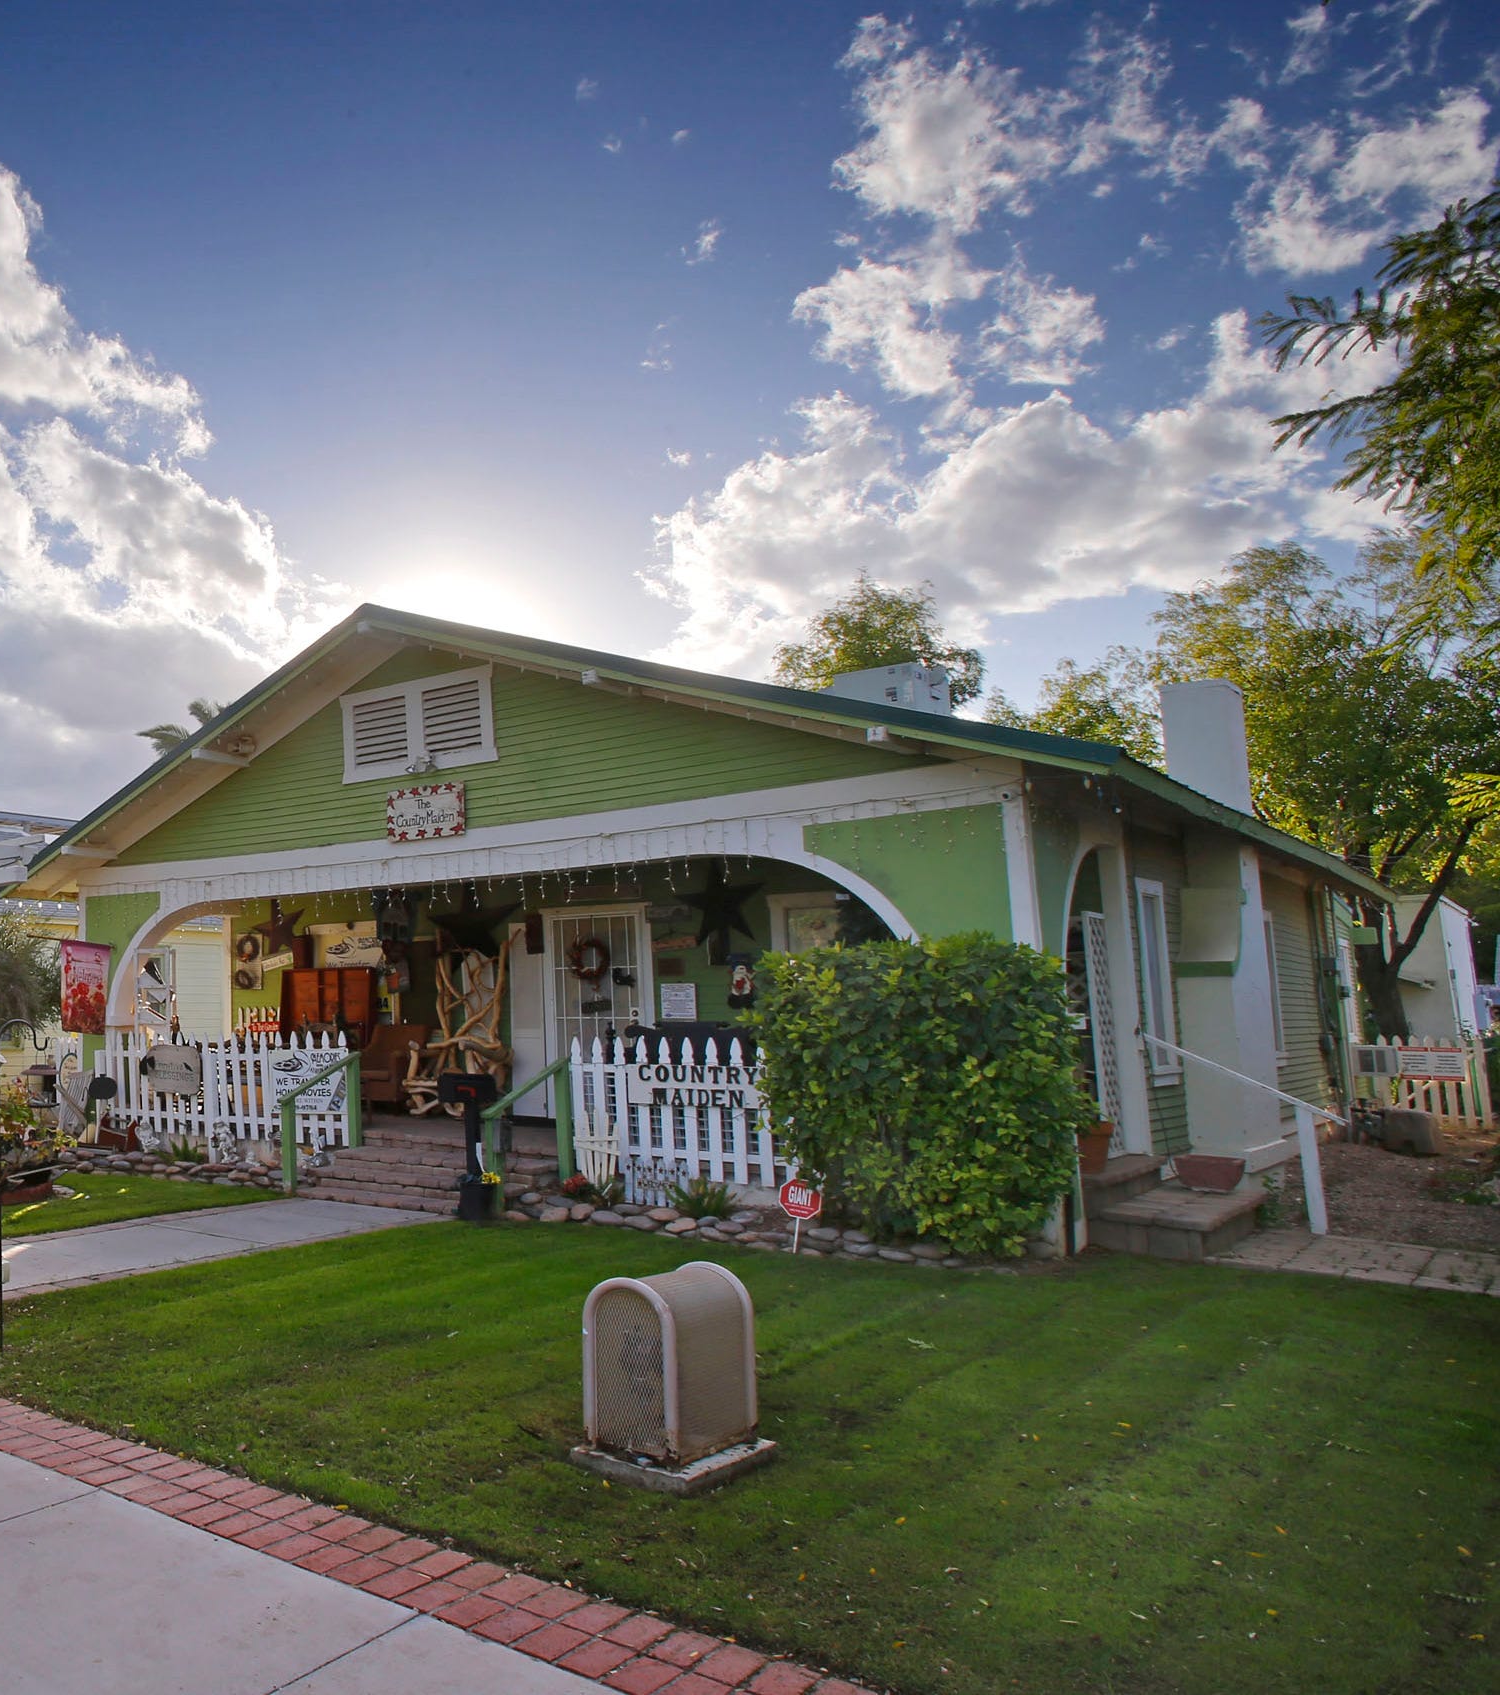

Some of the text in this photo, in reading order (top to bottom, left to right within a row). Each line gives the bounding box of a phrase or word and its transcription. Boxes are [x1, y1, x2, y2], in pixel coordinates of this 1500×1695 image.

[415, 799, 431, 810] The
[427, 809, 455, 825] Maiden
[276, 1078, 289, 1086] WE
[638, 1064, 758, 1085] COUNTRY
[651, 1088, 743, 1109] MAIDEN
[789, 1186, 812, 1207] GIANT
